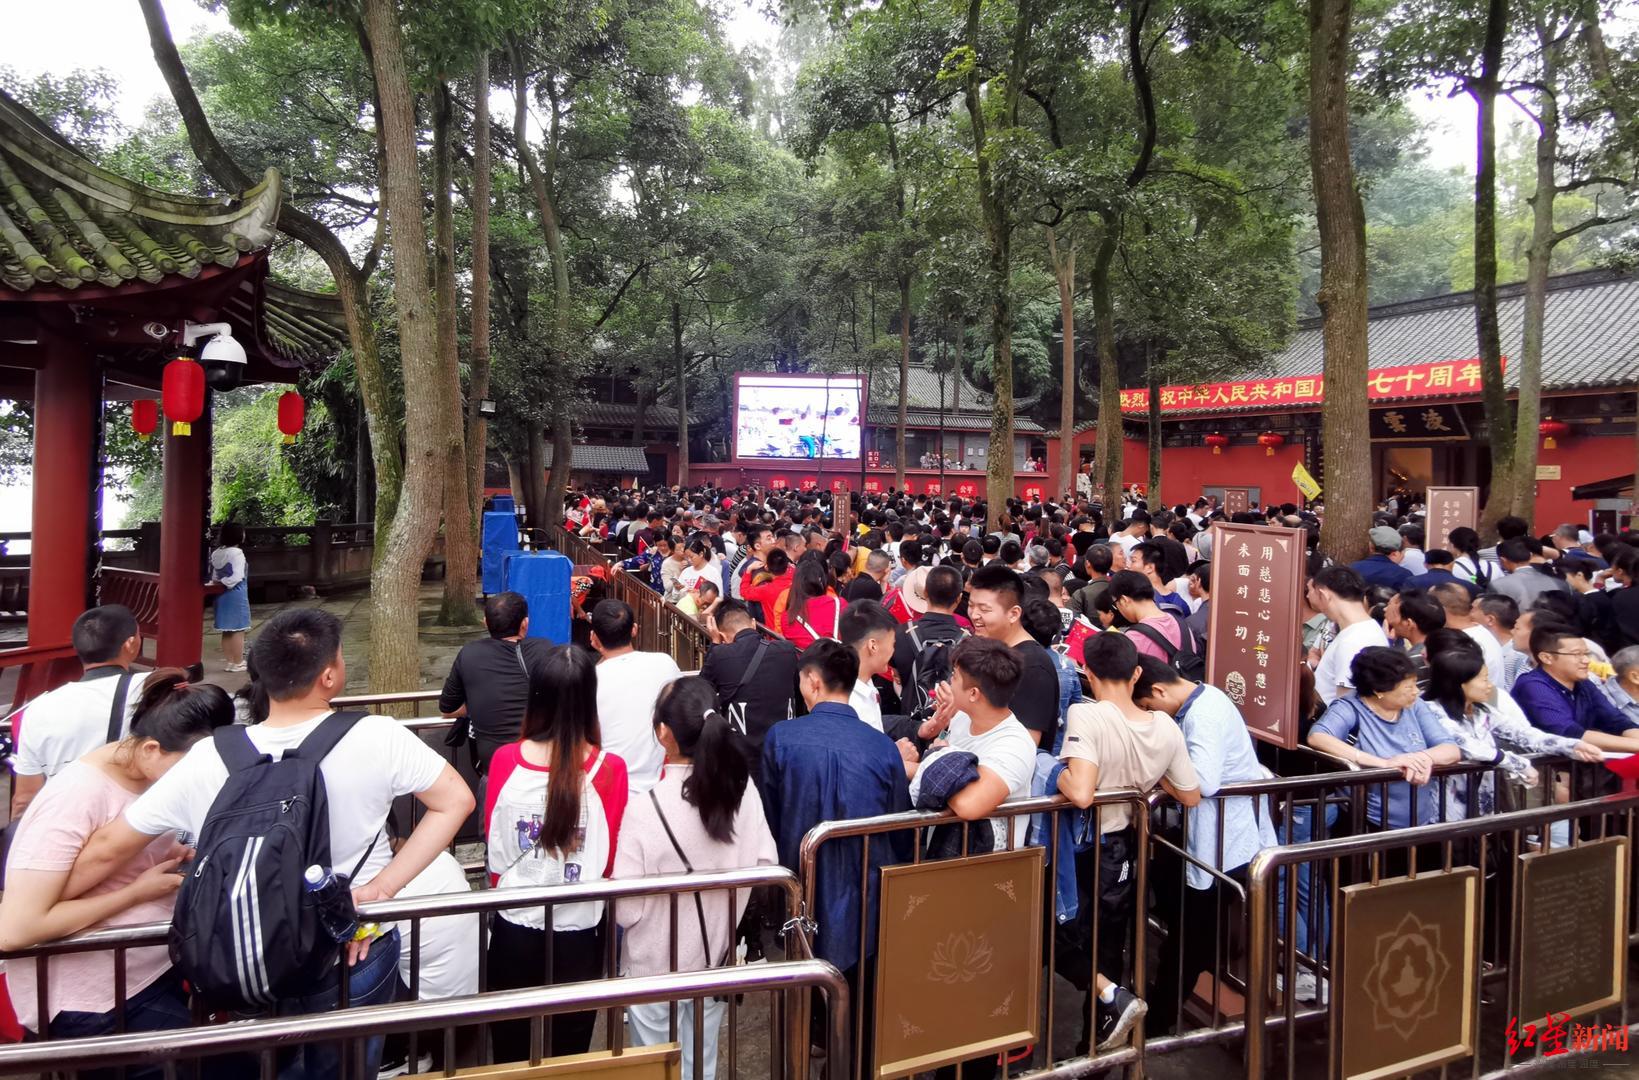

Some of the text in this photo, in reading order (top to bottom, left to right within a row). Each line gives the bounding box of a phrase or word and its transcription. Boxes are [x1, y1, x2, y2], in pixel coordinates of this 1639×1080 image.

[1253, 546, 1273, 706] 用慈悲心和智慧心
